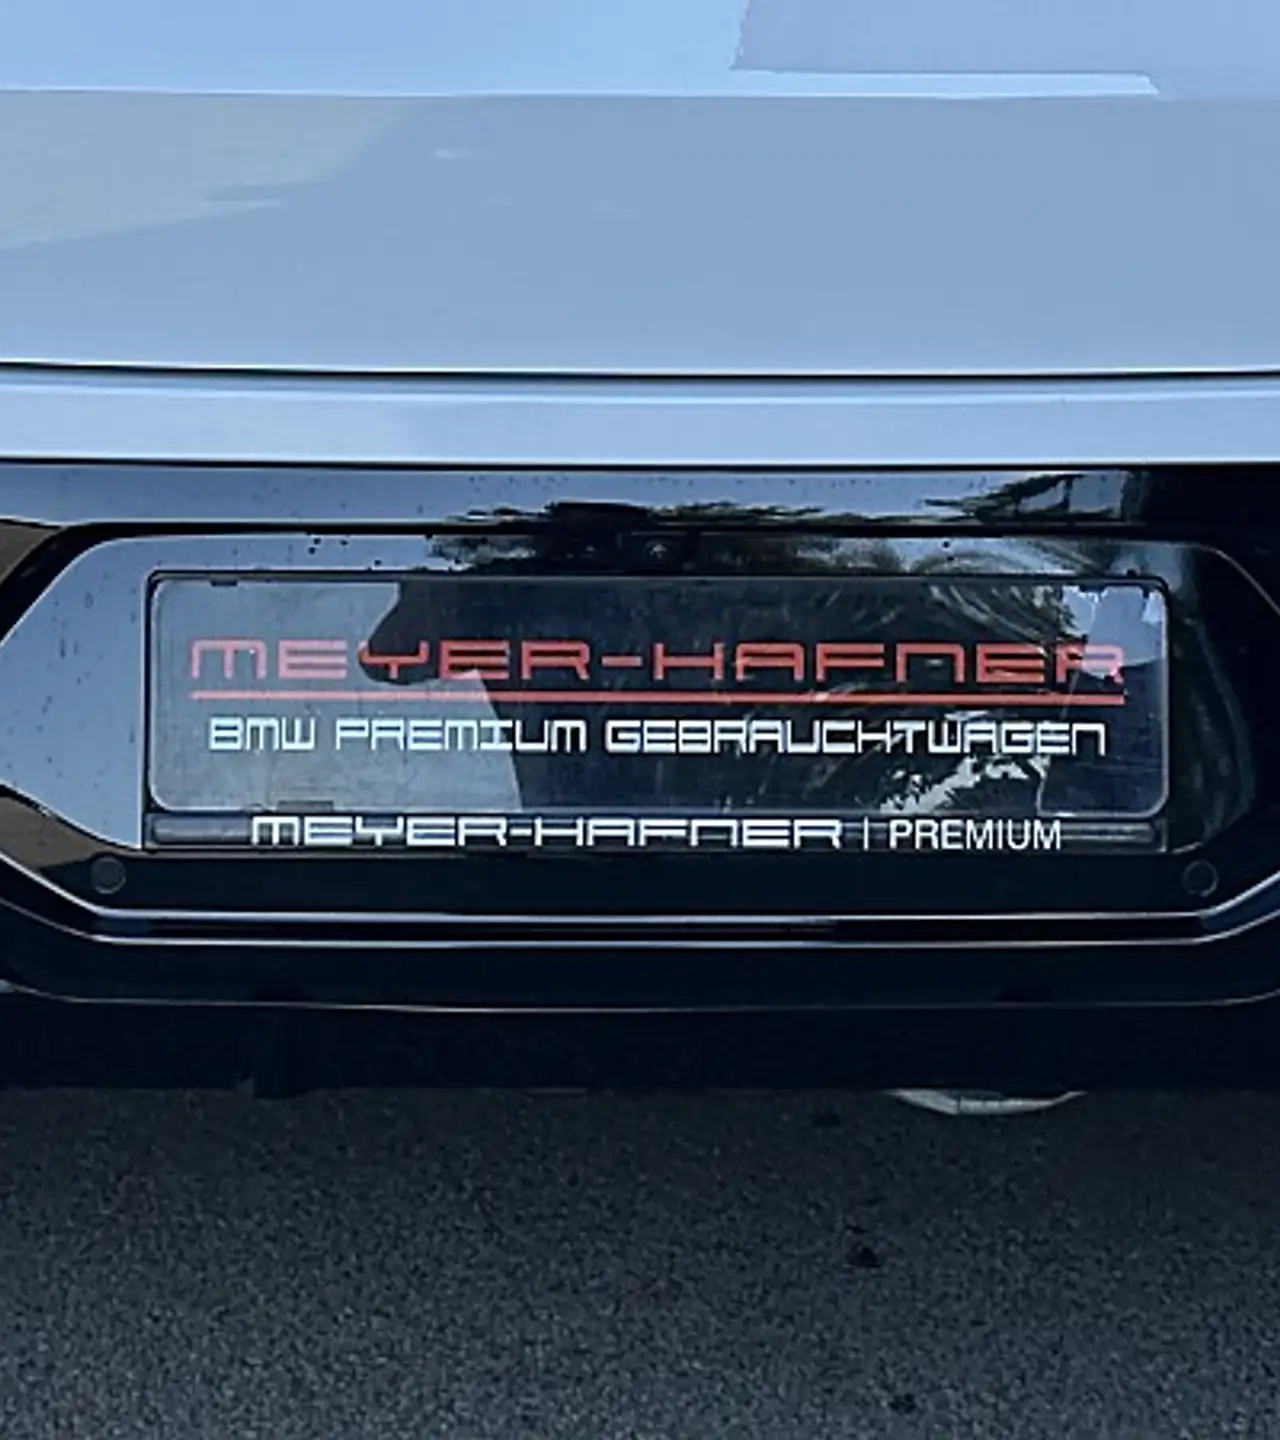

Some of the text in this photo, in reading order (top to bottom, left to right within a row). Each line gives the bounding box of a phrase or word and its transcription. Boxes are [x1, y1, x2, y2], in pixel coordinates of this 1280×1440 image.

[191, 639, 1126, 684] MEYER-HAFNER
[209, 717, 1106, 756] BMW PREMIUM GEBRAUCHTWAGEN
[251, 815, 1062, 851] MEYER-HAFNER PREMIUM
